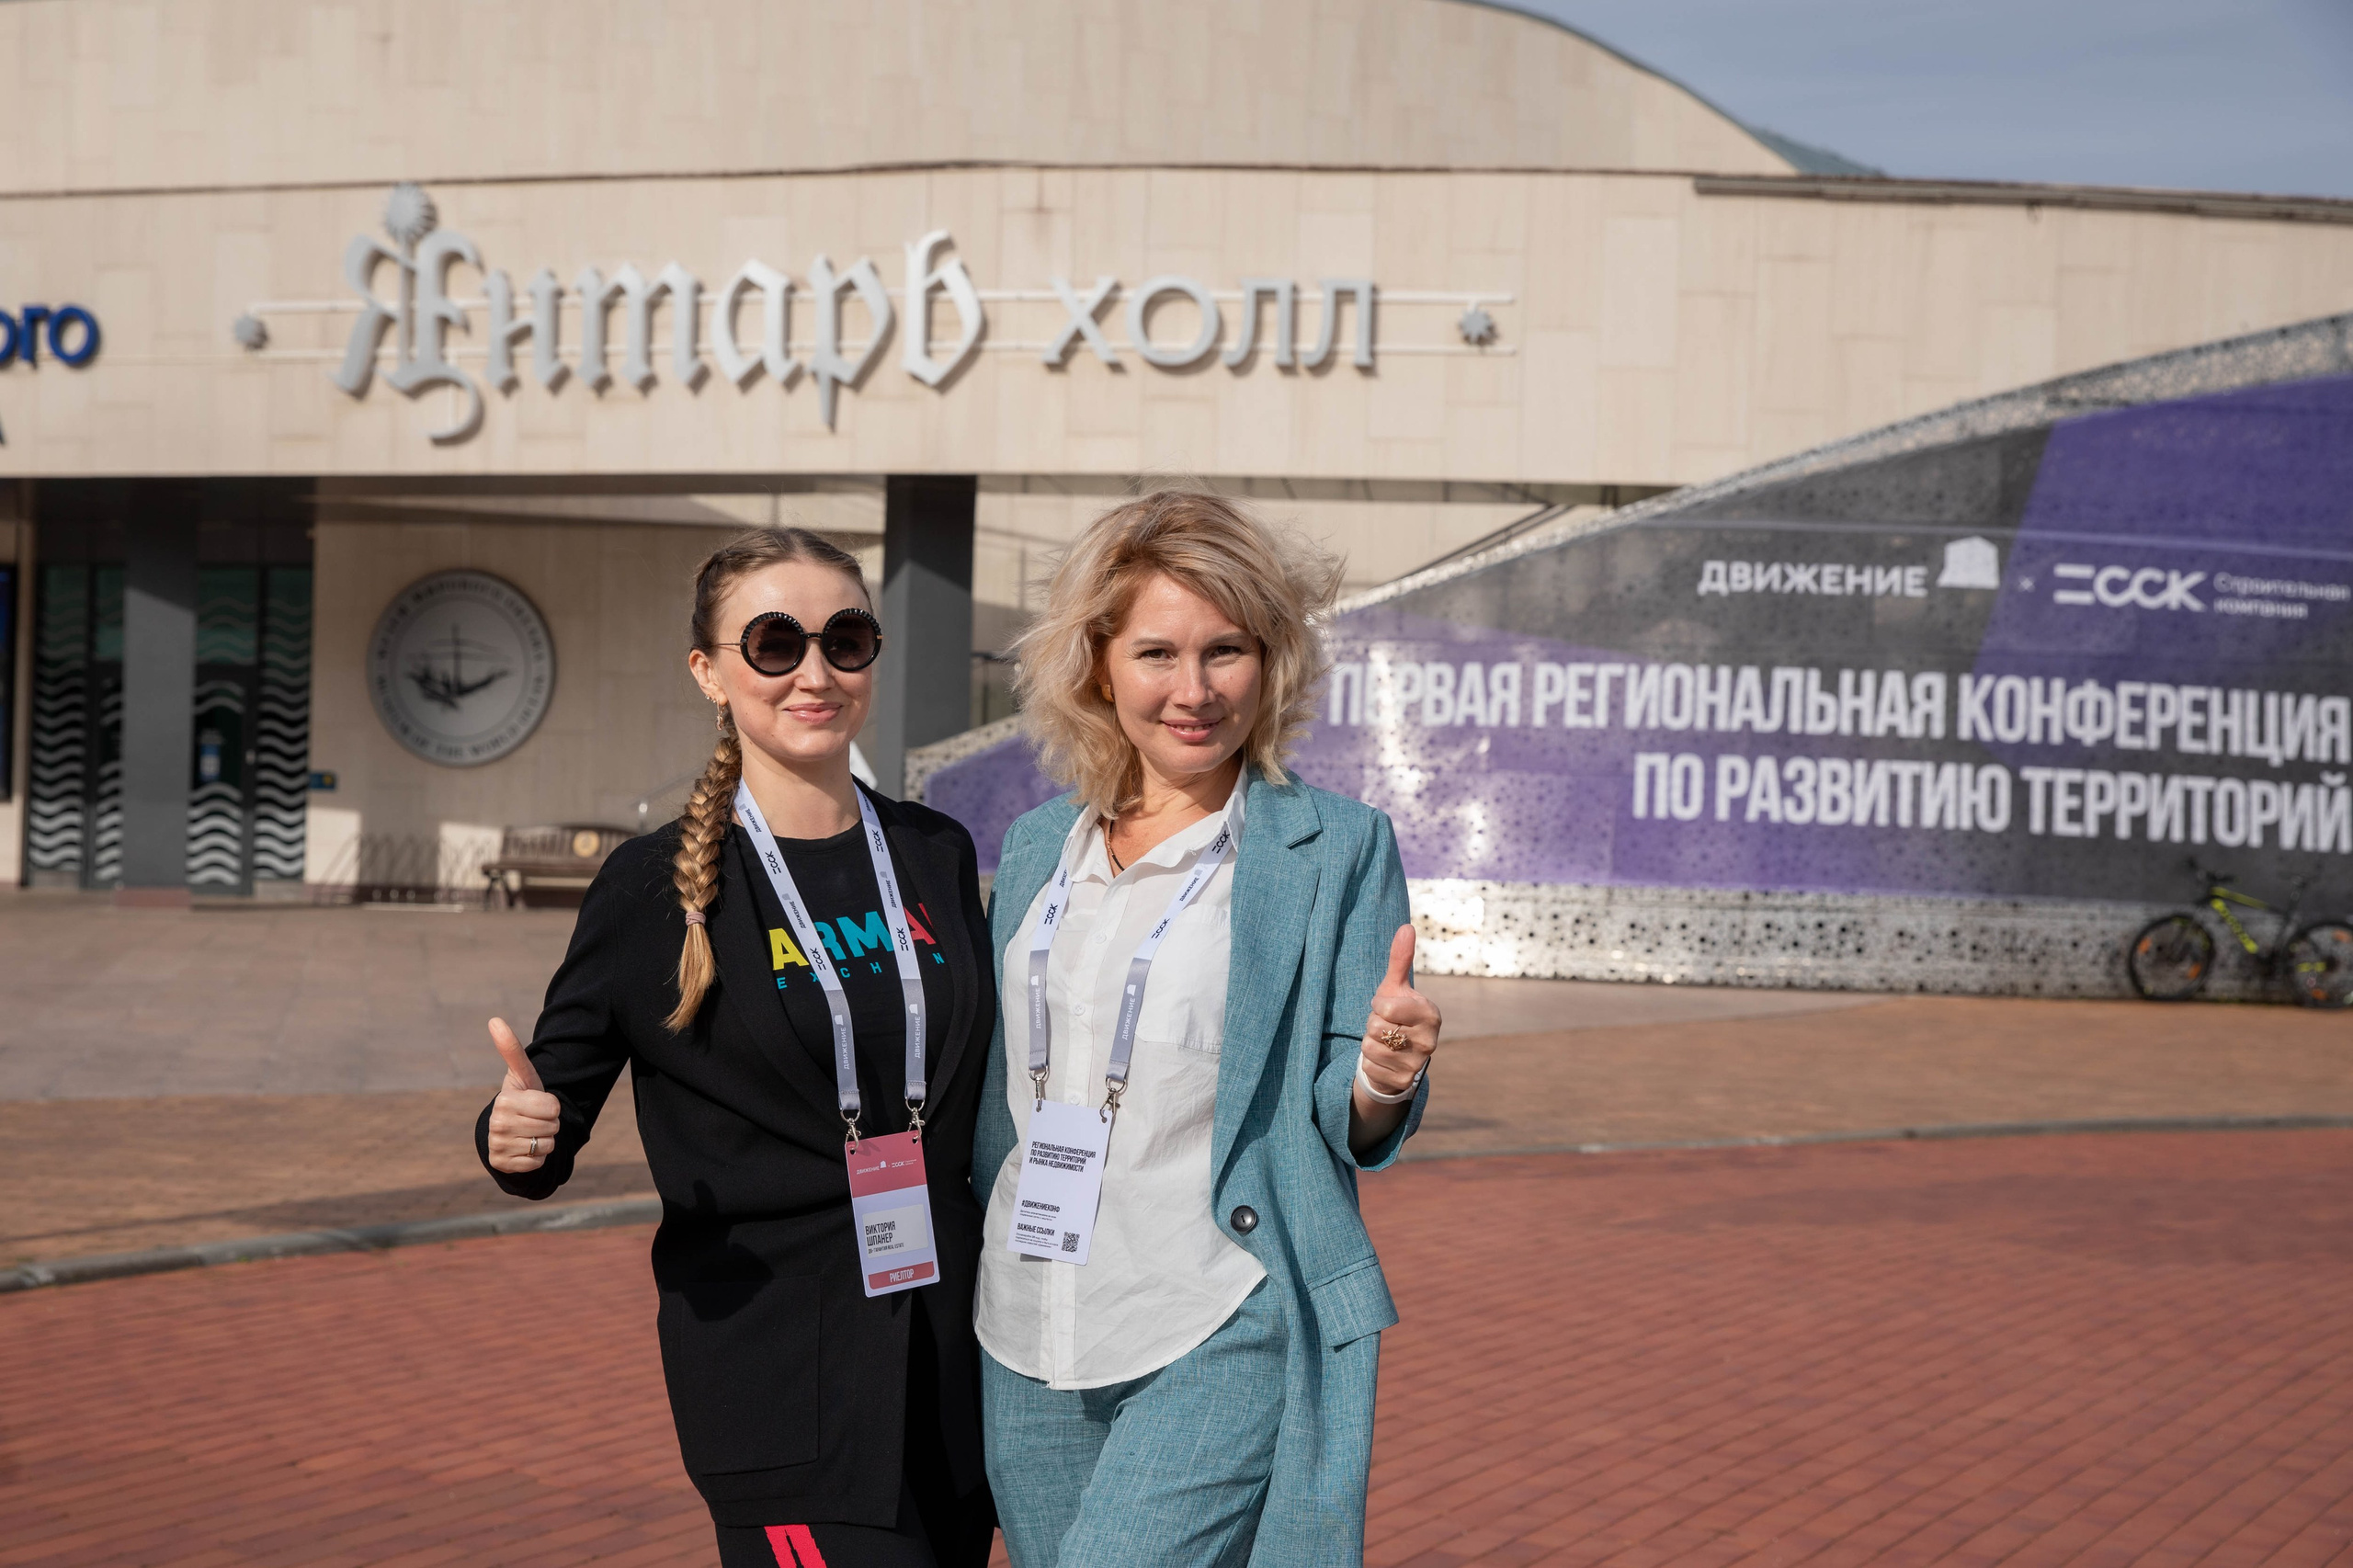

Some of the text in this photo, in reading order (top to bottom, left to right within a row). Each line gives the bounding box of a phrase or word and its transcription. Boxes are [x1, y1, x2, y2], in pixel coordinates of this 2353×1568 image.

[1697, 560, 1928, 597] ДВИЖЕНИЕ
[1329, 661, 2351, 767] ПЕРВАЯ РЕГИОНАЛЬНАЯ КОНФЕРЕНЦИЯ
[1632, 752, 2353, 854] ПО РАЗВИТИЮ ТЕРРИТОРИЙ
[745, 808, 762, 833] ДВИЖЕНИЕ
[885, 880, 897, 908] ДВИЖЕНИЕ
[789, 901, 806, 929] ДВИЖЕНИЕ
[768, 903, 937, 971] ARMA
[1121, 997, 1136, 1040] ДВИЖЕНИЕ
[840, 1027, 850, 1070] ДВИЖЕНИЕ
[1030, 1148, 1086, 1165] ПО РАЗВИТИЮ ТЕРРИТОРИЙ
[1031, 1141, 1097, 1159] РЕГИОНАЛЬНАЯ КОНФЕРЕНЦИЯ
[1032, 1157, 1049, 1166] РЫНКА
[1048, 1160, 1085, 1173] НЕДВИЖИМОСТИ
[865, 1221, 896, 1235] ВИКТОРИЯ
[866, 1233, 893, 1246] ШПАНЕР
[1017, 1222, 1055, 1237] ВАЖНЫЕ ССЫЛКИ
[889, 1268, 915, 1283] РИЕЛТОР
